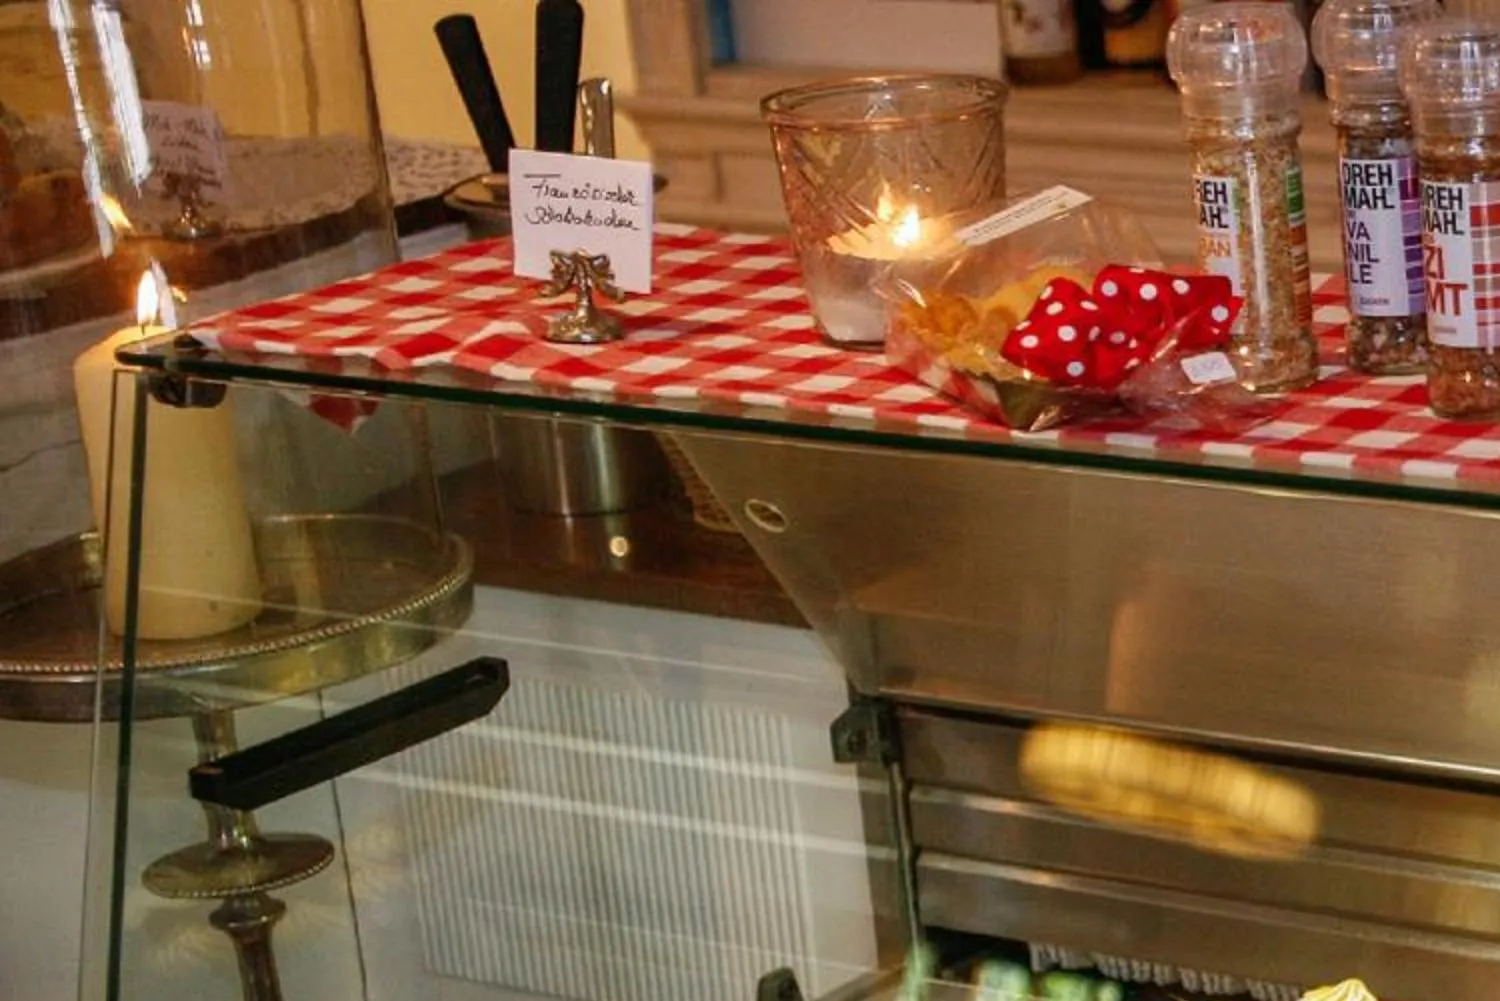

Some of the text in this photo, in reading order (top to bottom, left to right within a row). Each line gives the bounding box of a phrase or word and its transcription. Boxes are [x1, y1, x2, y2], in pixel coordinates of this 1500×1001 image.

[1424, 185, 1463, 210] REH
[1199, 203, 1229, 229] AHL
[1348, 221, 1371, 241] VA
[1348, 242, 1380, 263] NIL
[1350, 264, 1373, 284] LE
[1426, 281, 1469, 316] MT
